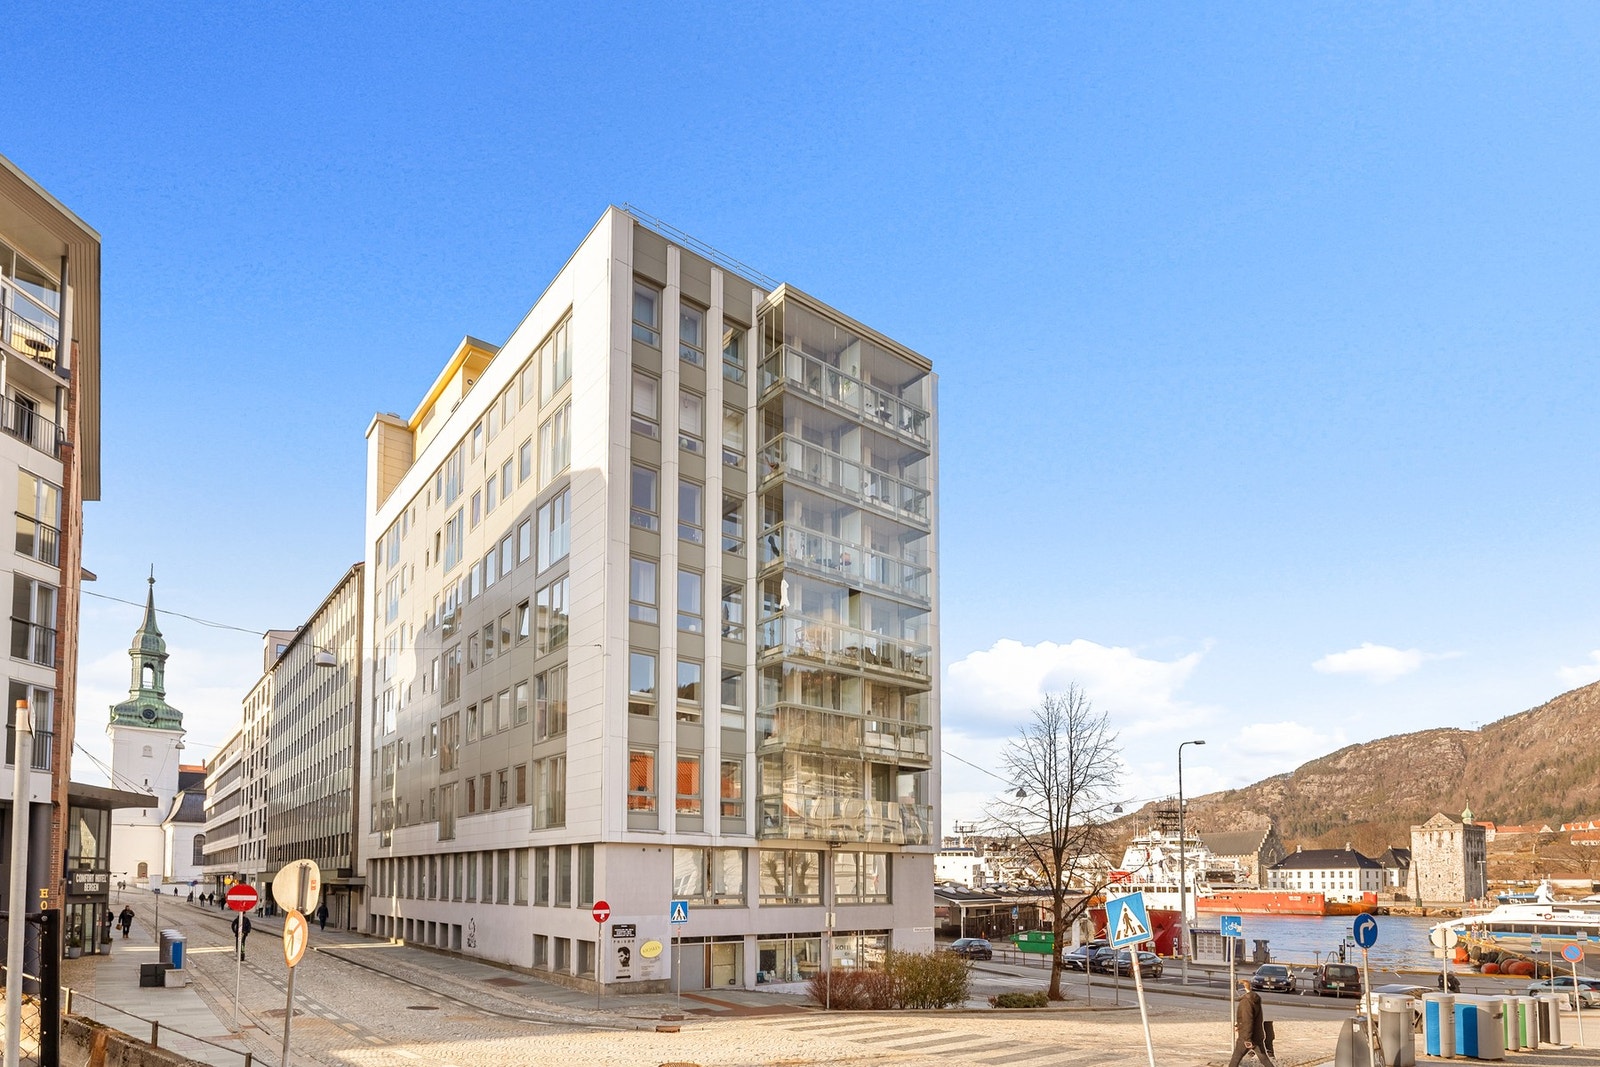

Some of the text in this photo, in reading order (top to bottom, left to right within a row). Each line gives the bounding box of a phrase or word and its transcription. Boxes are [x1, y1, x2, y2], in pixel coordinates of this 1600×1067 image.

[75, 873, 107, 883] COMFORT HOTEL
[83, 882, 100, 892] BERGEN
